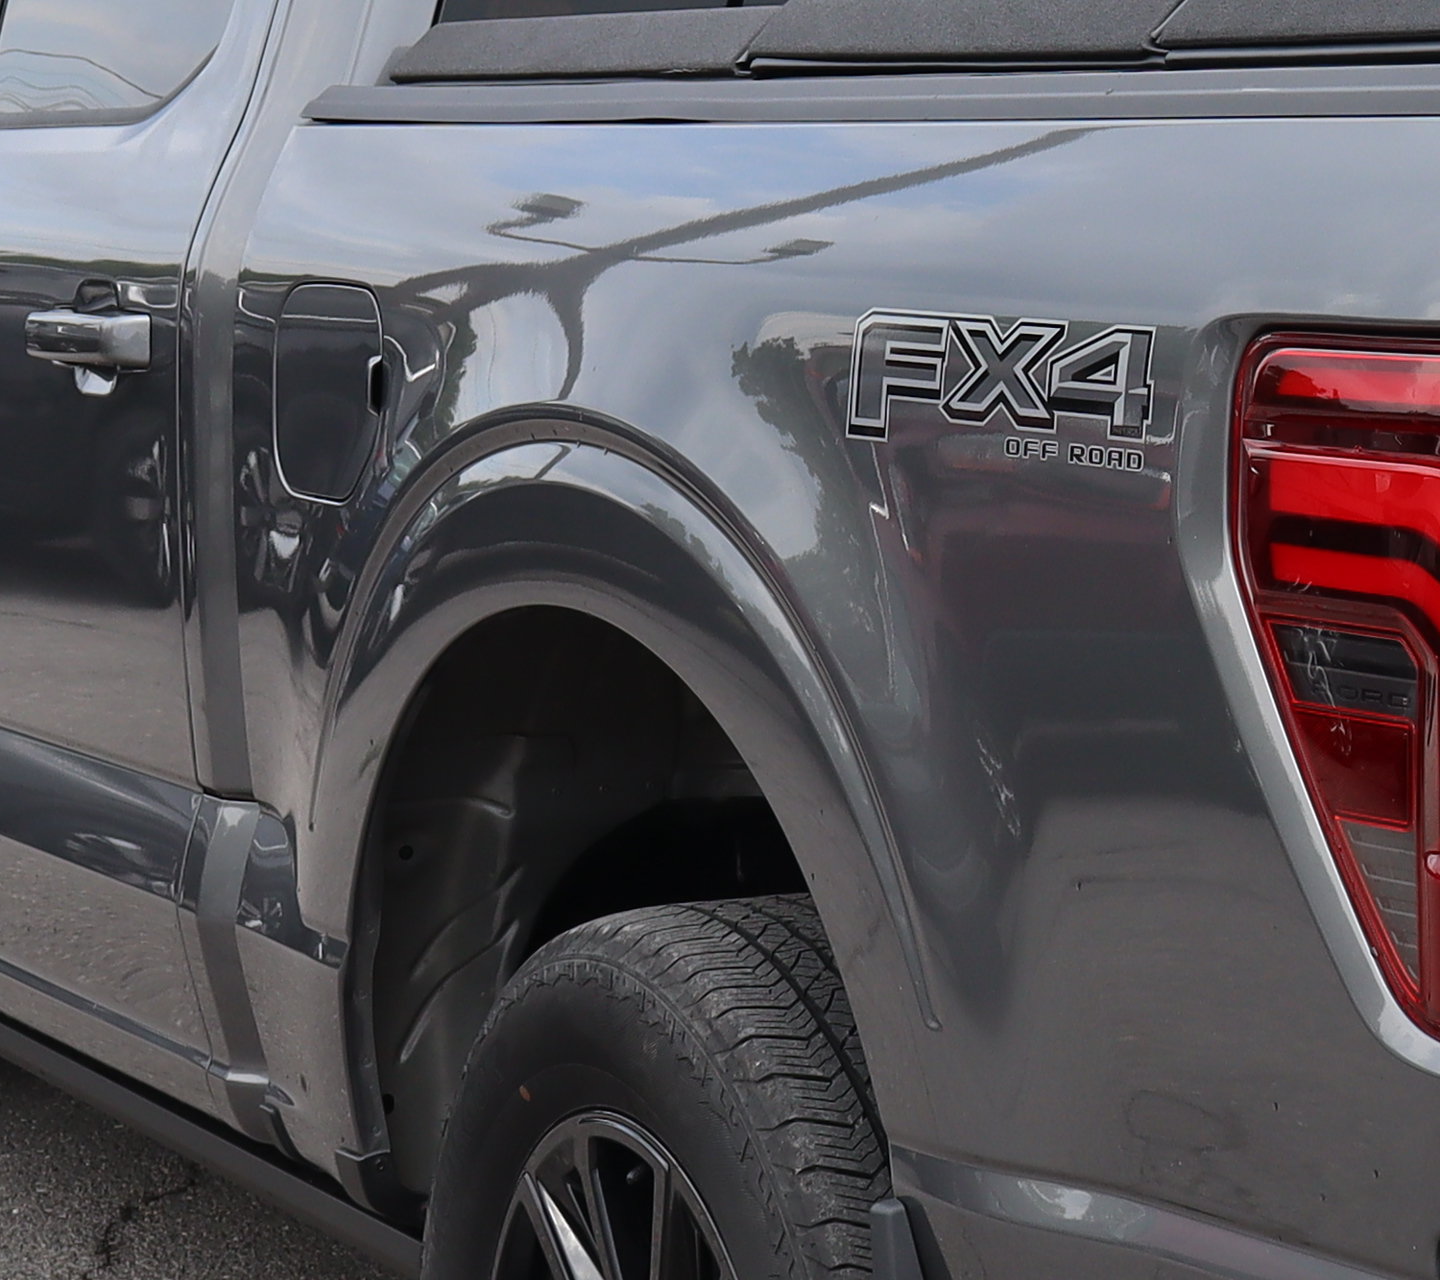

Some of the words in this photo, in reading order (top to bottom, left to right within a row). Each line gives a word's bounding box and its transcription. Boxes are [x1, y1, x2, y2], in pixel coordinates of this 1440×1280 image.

[846, 307, 1158, 443] FX4
[1004, 435, 1059, 461] OFF
[1067, 442, 1145, 472] ROAD
